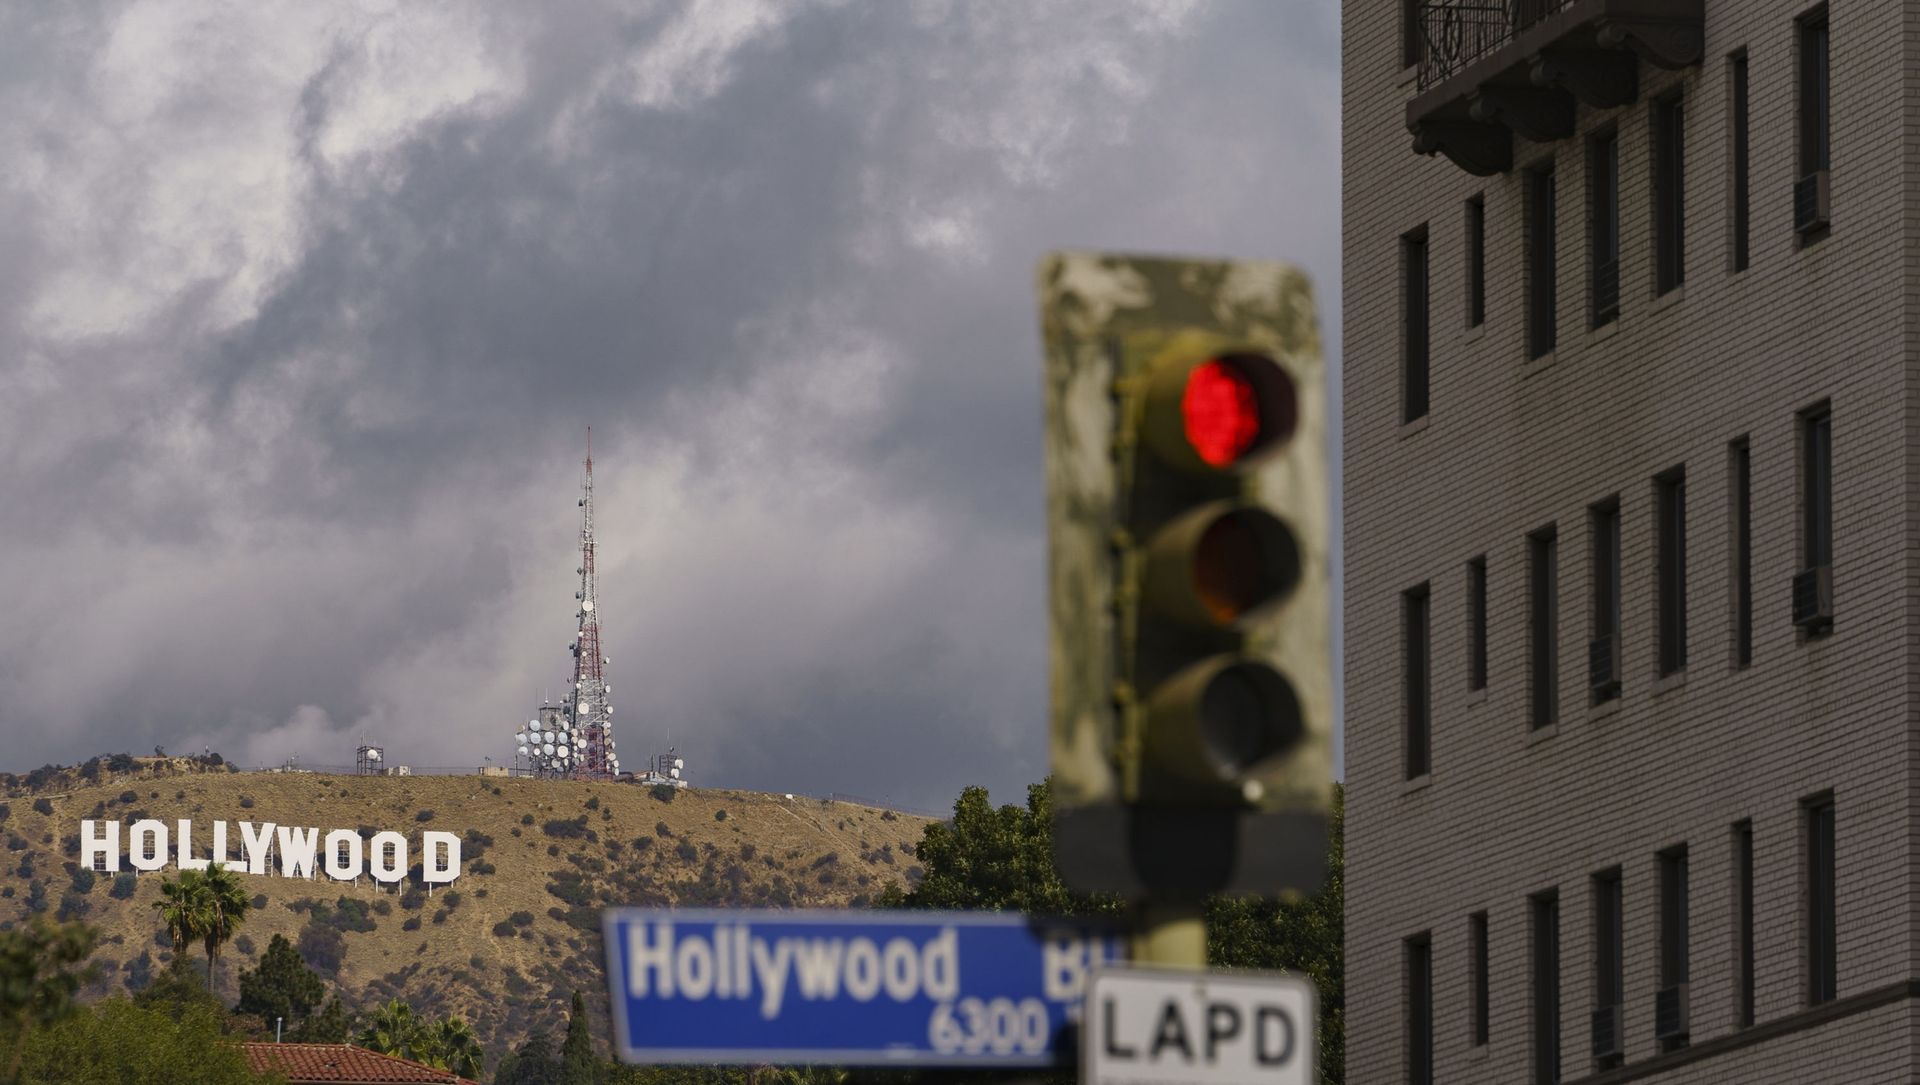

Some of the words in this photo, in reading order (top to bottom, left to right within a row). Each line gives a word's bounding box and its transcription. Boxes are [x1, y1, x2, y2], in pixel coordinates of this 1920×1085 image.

[80, 818, 461, 883] HOLLYWOOD
[628, 918, 958, 1019] Hollywood
[928, 998, 1048, 1055] 6300
[1102, 995, 1297, 1067] LAPD
